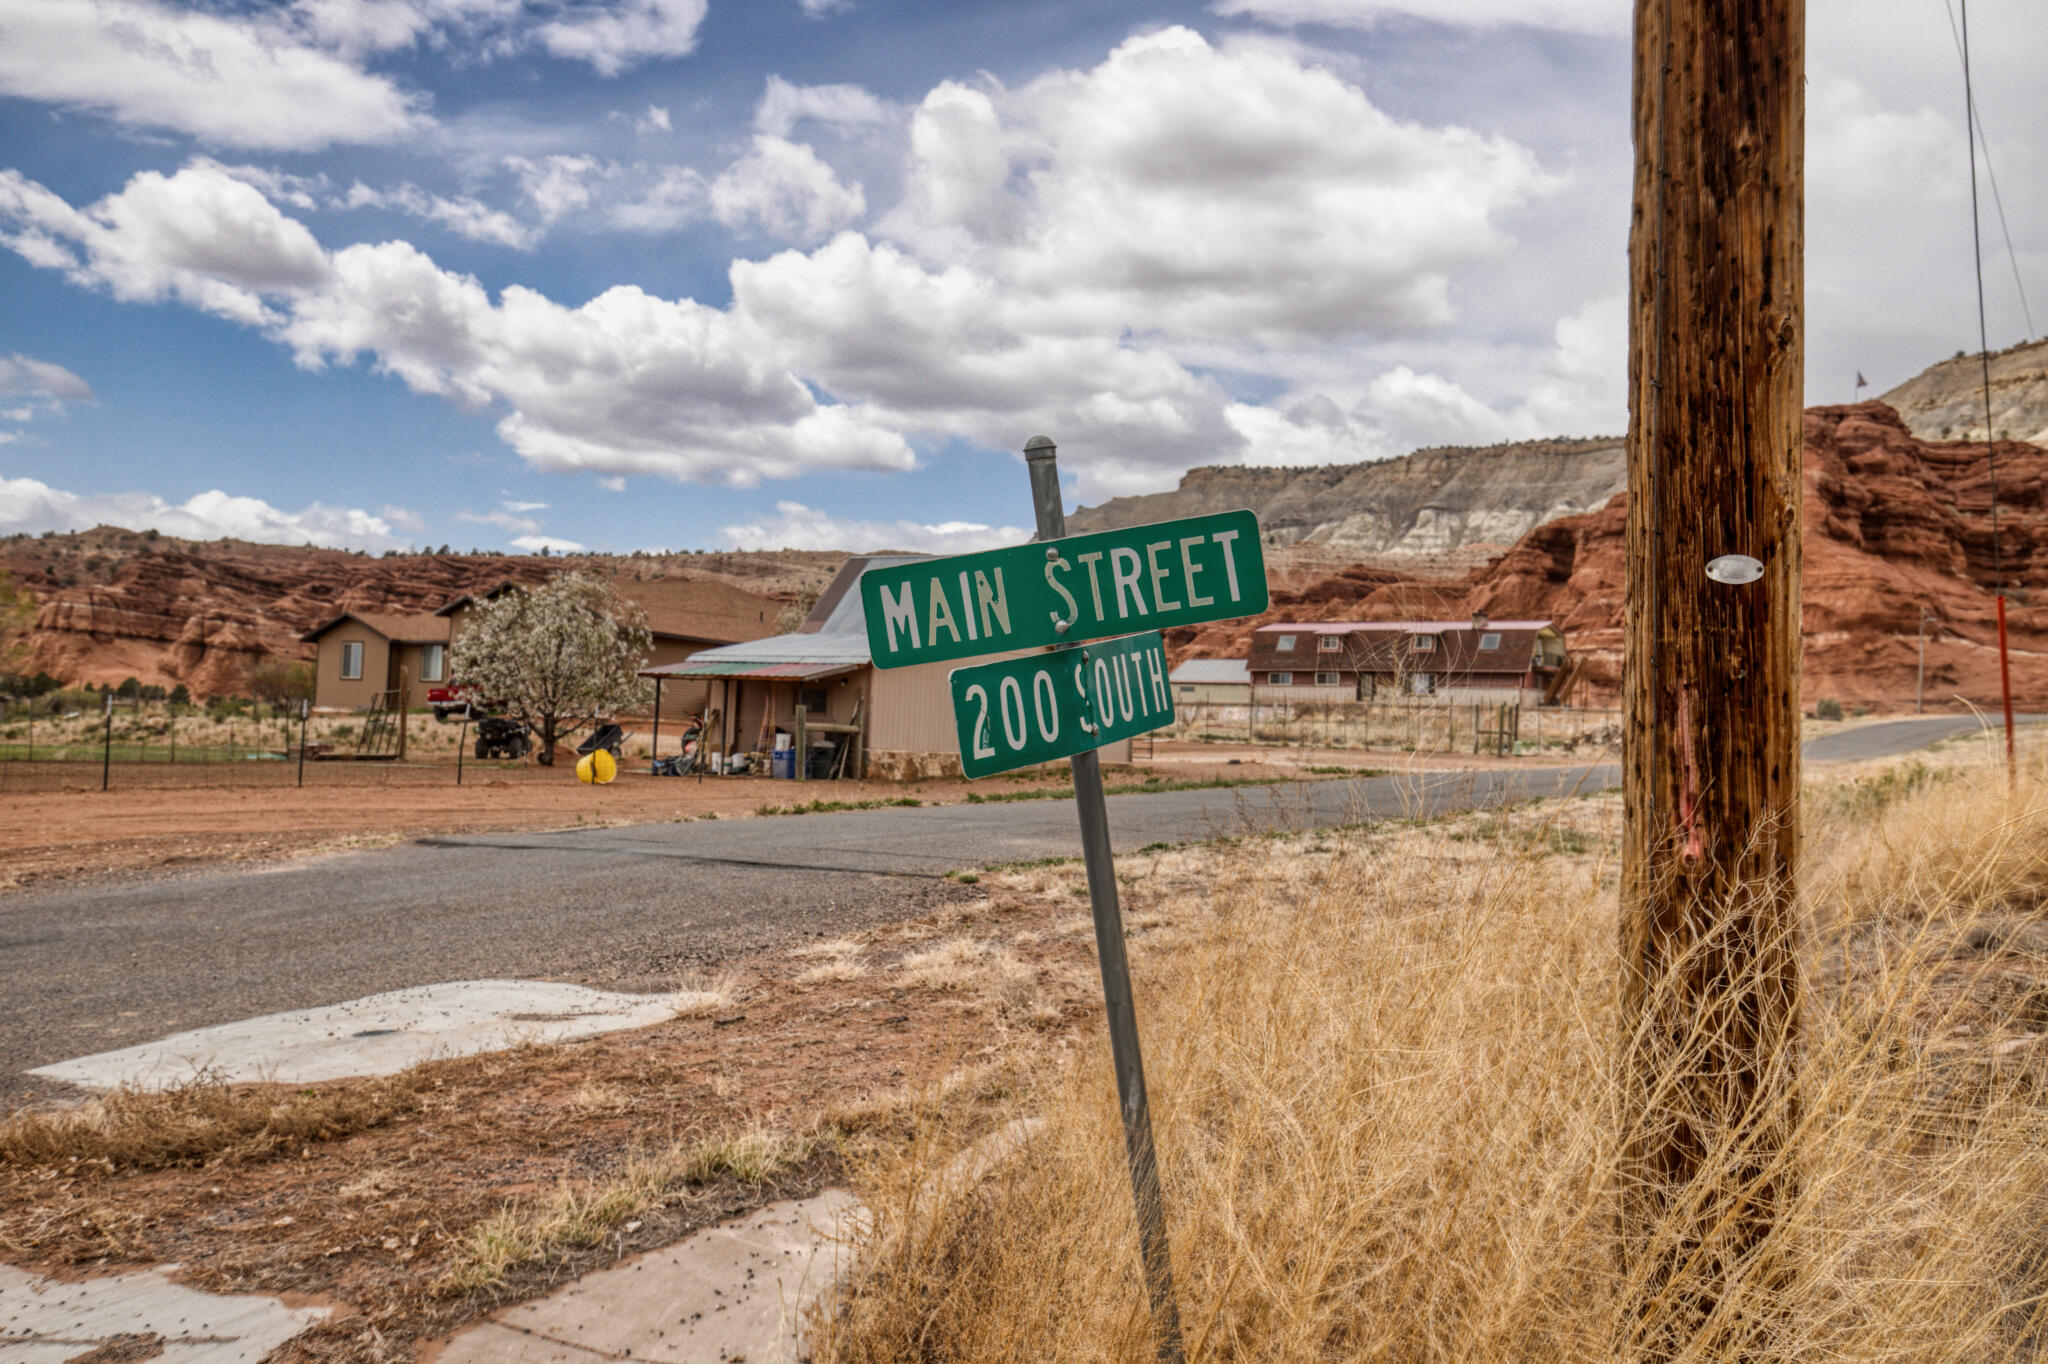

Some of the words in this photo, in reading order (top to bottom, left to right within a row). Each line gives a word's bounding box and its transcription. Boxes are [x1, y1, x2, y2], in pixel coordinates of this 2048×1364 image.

[880, 567, 1012, 652] MAIN
[1045, 529, 1239, 628] STREET
[965, 670, 1059, 760] 200
